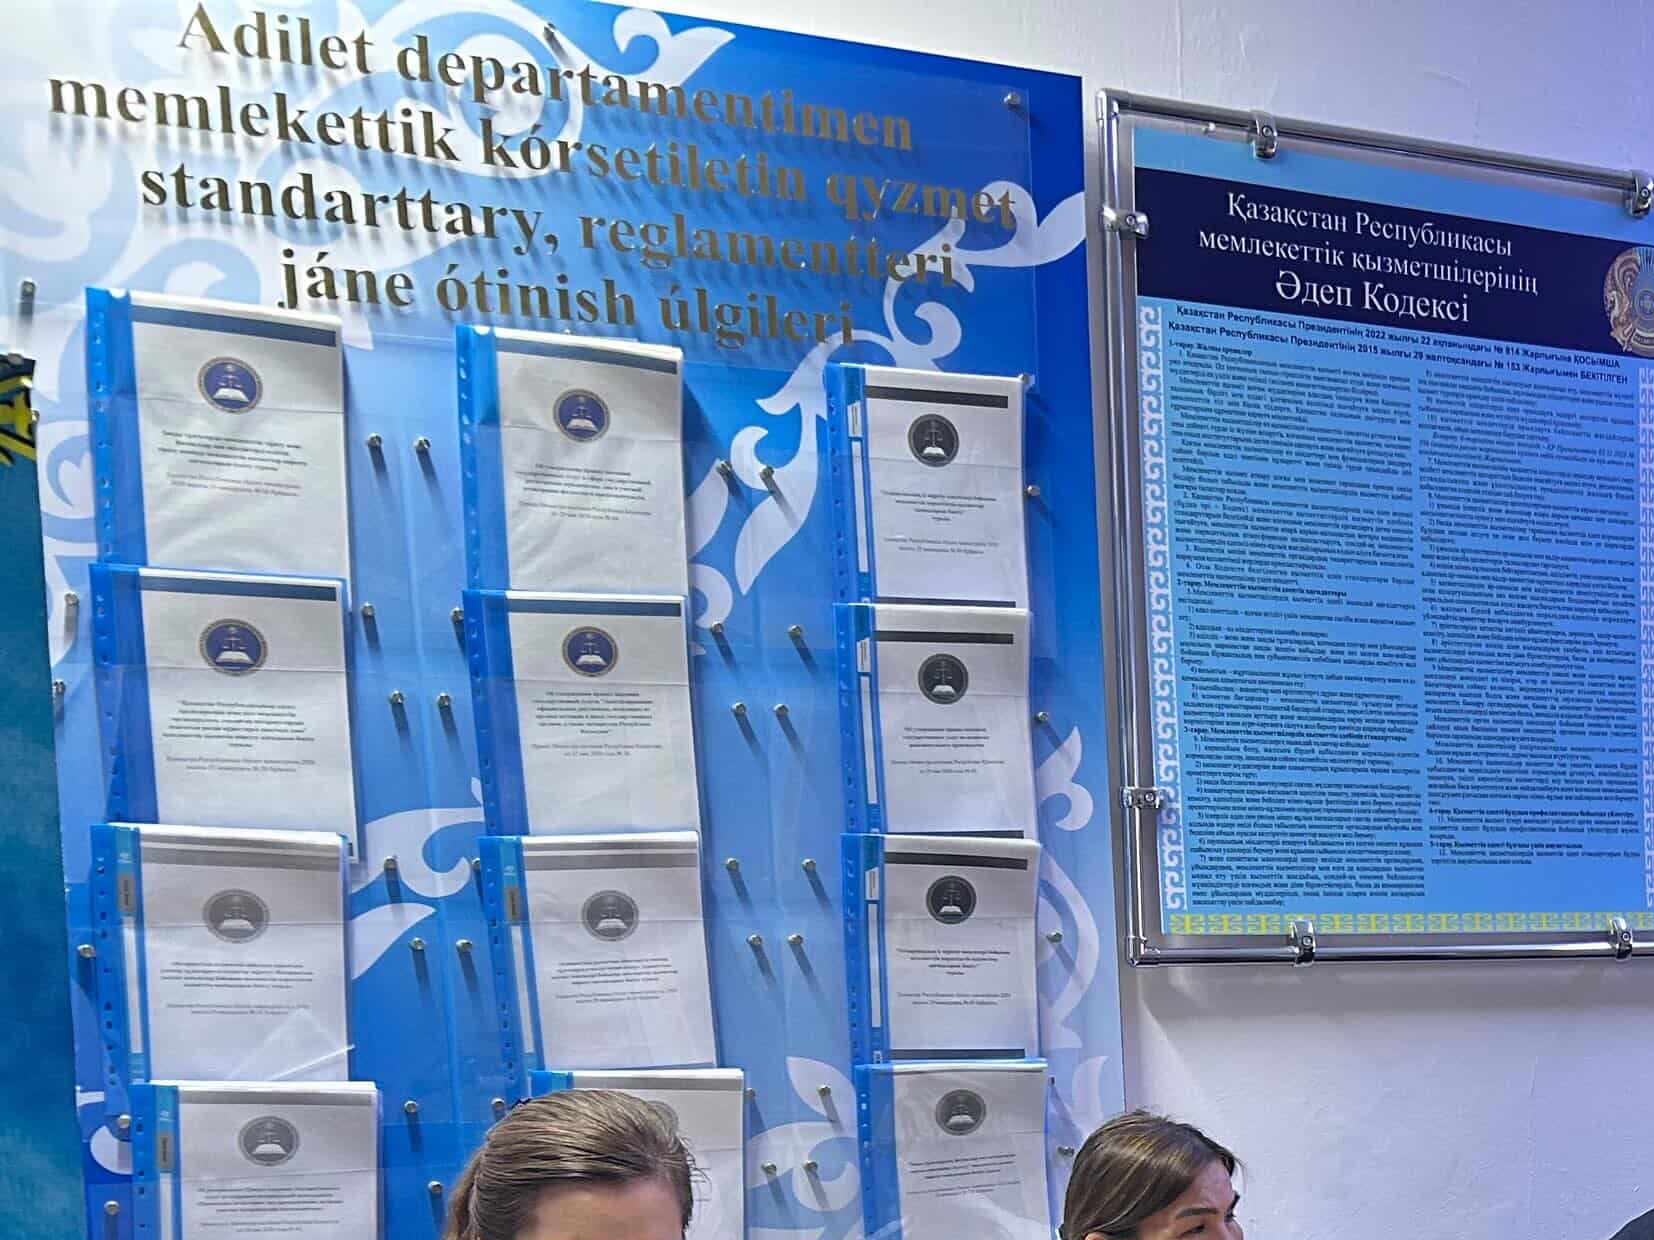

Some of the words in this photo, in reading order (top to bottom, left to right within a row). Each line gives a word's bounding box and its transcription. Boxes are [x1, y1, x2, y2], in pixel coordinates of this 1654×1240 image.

[178, 2, 374, 75] Adilet
[396, 34, 914, 152] departamentimen
[49, 77, 460, 163] memlekettik
[480, 116, 808, 200] kórsetiletin
[824, 170, 1017, 229] qyzmet
[141, 161, 560, 256] standarttary,
[578, 213, 955, 287] reglamentteri
[1227, 191, 1348, 234] Қазақстан
[1355, 211, 1513, 258] Республикасы
[1198, 228, 1346, 267] мемлекеттік
[1351, 251, 1539, 298] қызметшілерінің
[1275, 269, 1354, 308] Әдеп
[1361, 280, 1471, 323] Кодексі
[277, 247, 415, 309] jáne
[436, 262, 637, 326] ótinish
[659, 279, 855, 350] úlgileri
[1226, 311, 1297, 330] Республикасы
[1365, 328, 1386, 340] 2022
[1420, 335, 1431, 345] 22
[1219, 327, 1289, 345] Республикасы
